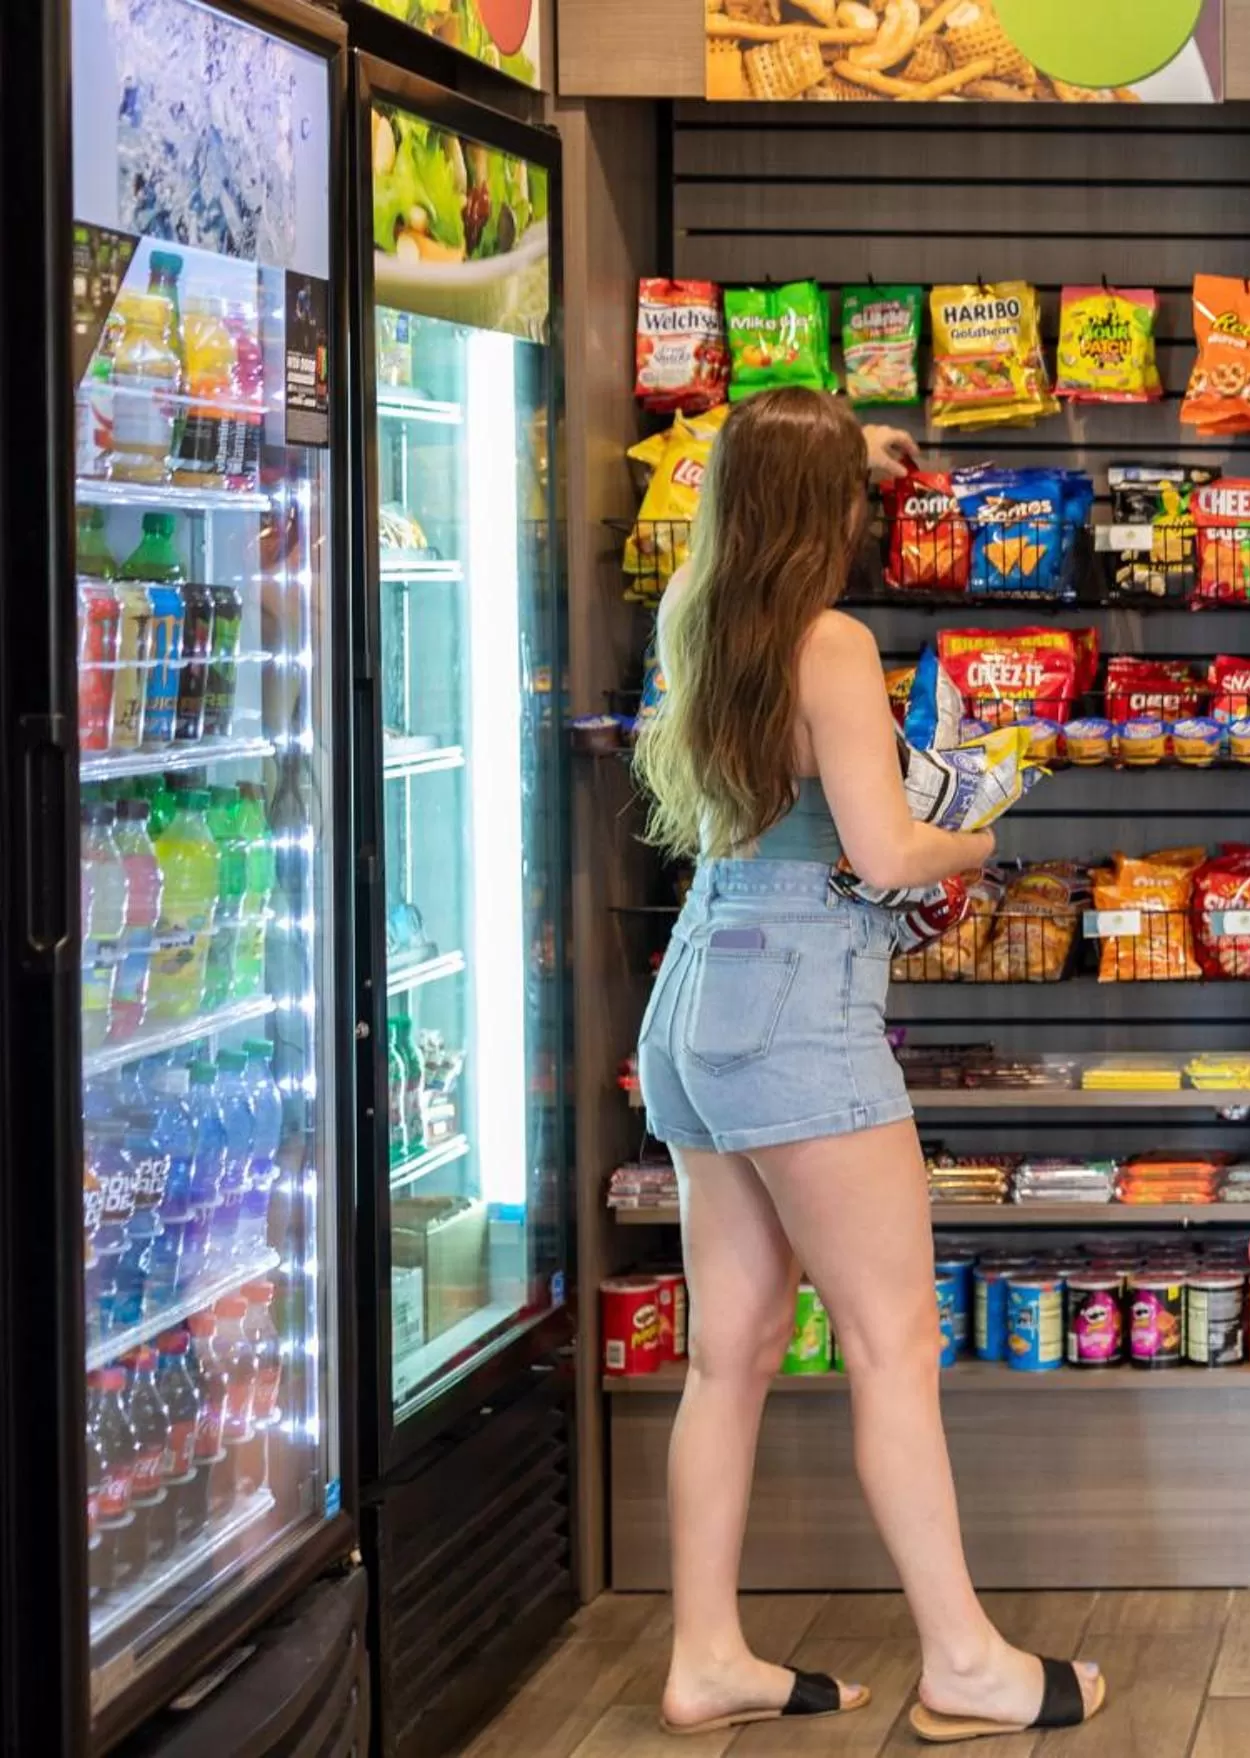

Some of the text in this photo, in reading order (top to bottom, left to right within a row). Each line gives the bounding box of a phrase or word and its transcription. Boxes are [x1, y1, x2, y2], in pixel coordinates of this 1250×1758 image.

[944, 299, 1020, 325] HARIBO
[730, 315, 776, 331] Mike
[950, 324, 1020, 340] Goldbears
[1079, 340, 1134, 357] PATCH
[904, 493, 960, 517] Dorito
